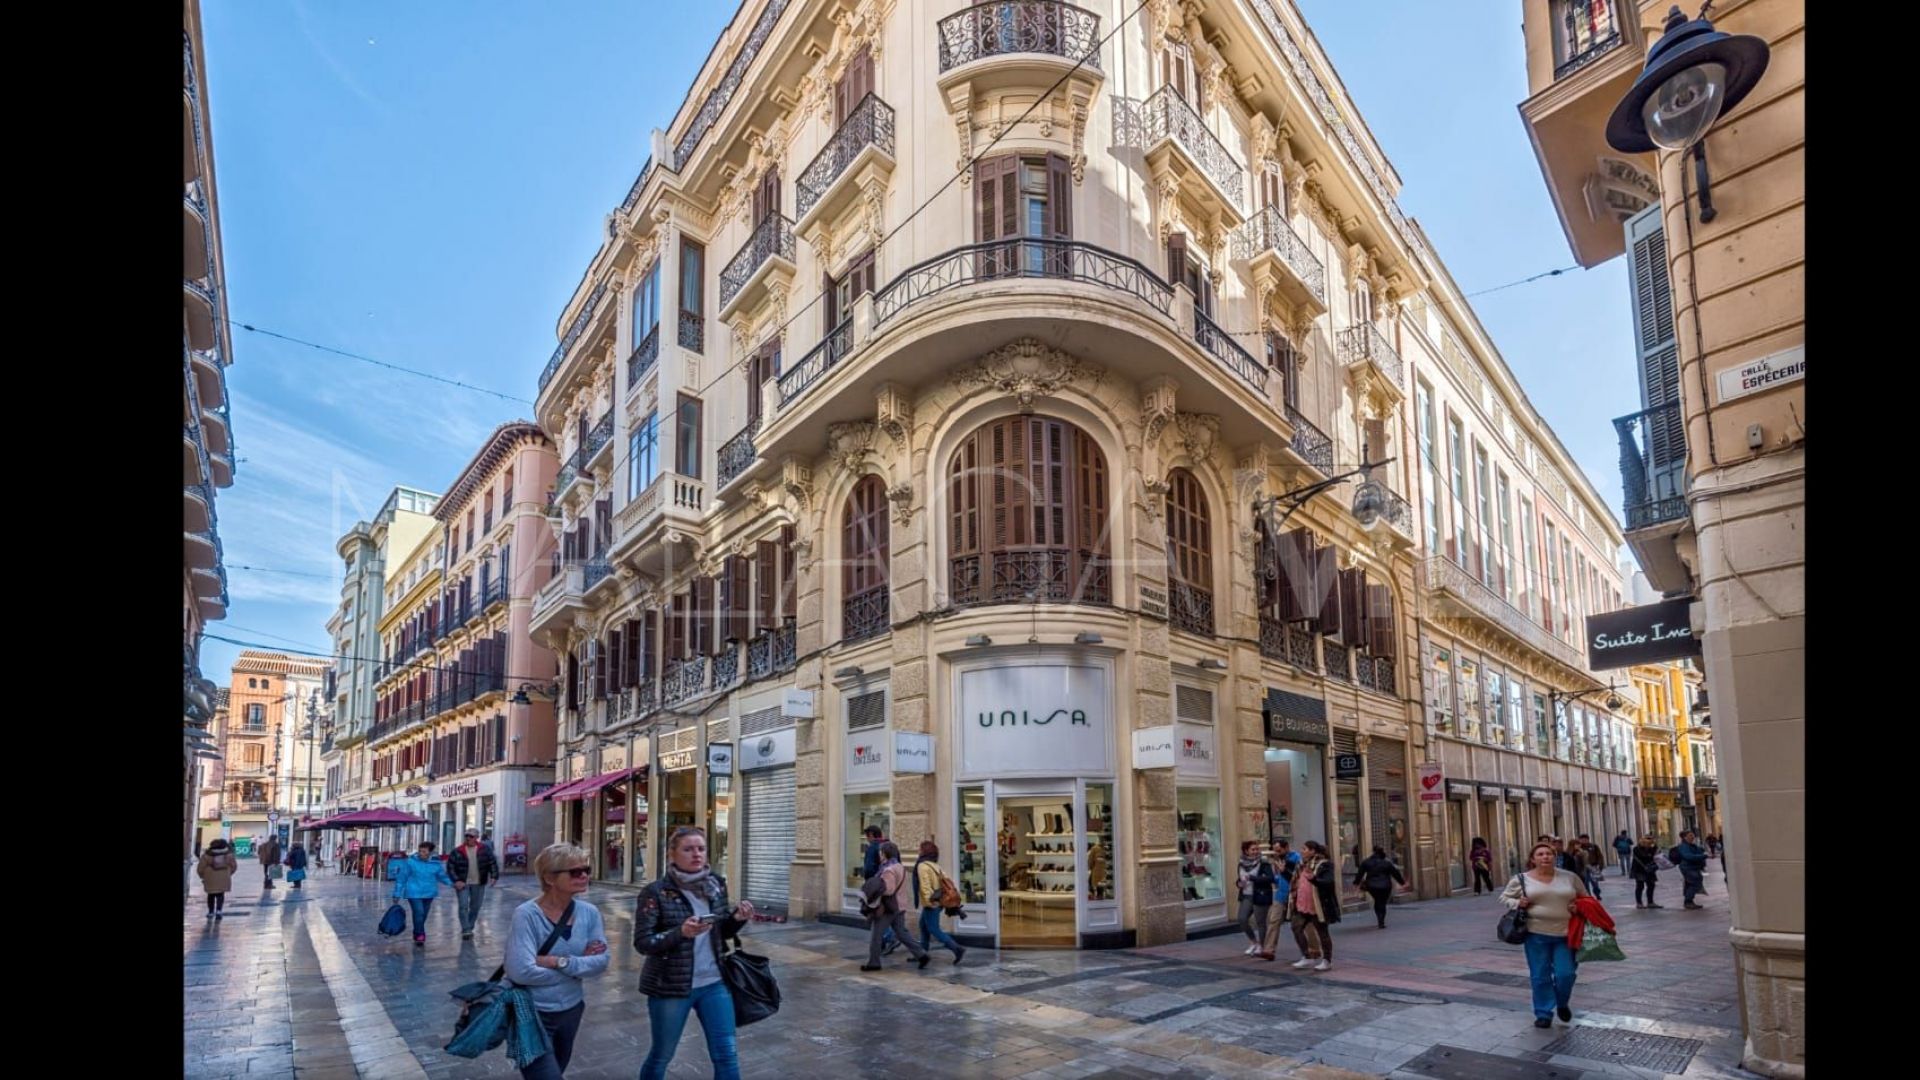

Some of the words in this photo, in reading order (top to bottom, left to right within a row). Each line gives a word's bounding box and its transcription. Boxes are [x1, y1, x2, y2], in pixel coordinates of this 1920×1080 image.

[1741, 362, 1768, 377] CALLE
[1593, 630, 1648, 650] Suits
[979, 709, 1087, 728] UNISA
